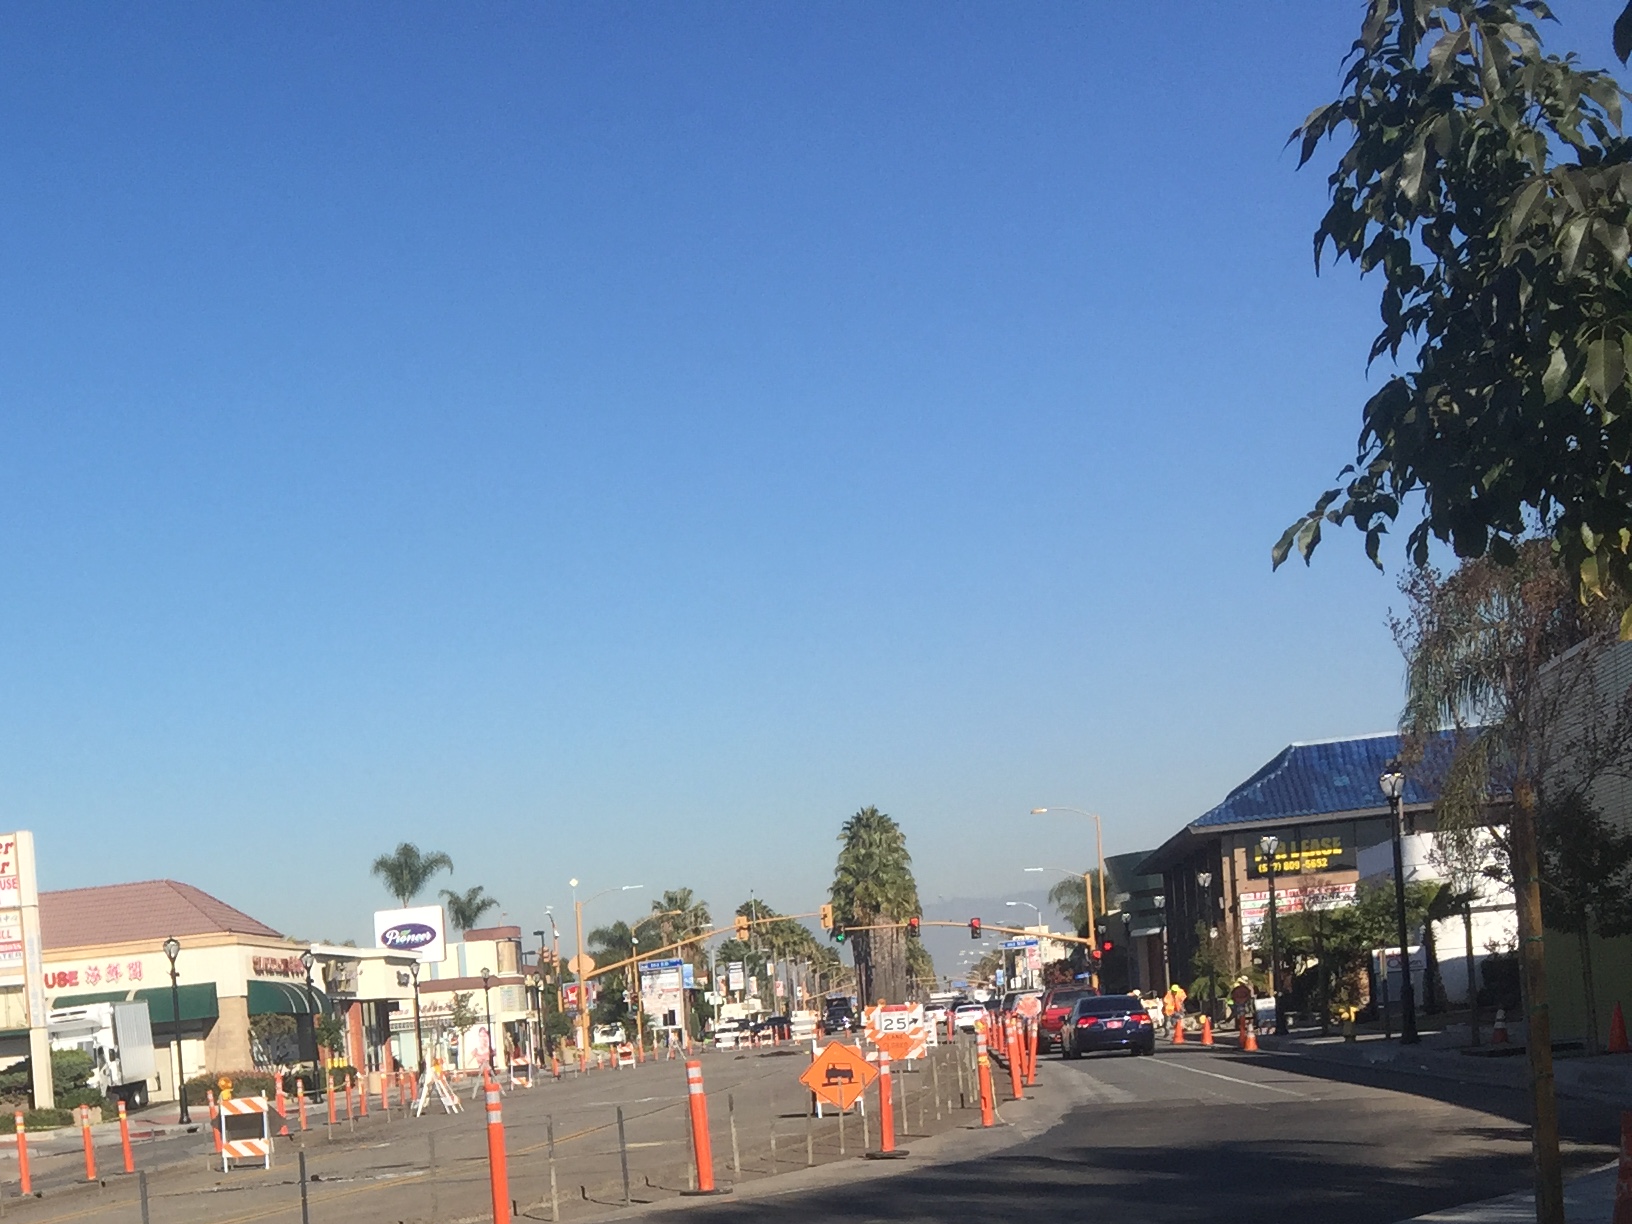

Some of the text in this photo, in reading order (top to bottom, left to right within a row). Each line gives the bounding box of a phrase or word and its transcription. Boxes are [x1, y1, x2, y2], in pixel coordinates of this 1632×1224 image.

[1254, 836, 1343, 862] FR LEASE
[385, 929, 432, 945] Pioneer
[883, 1015, 907, 1031] 25
